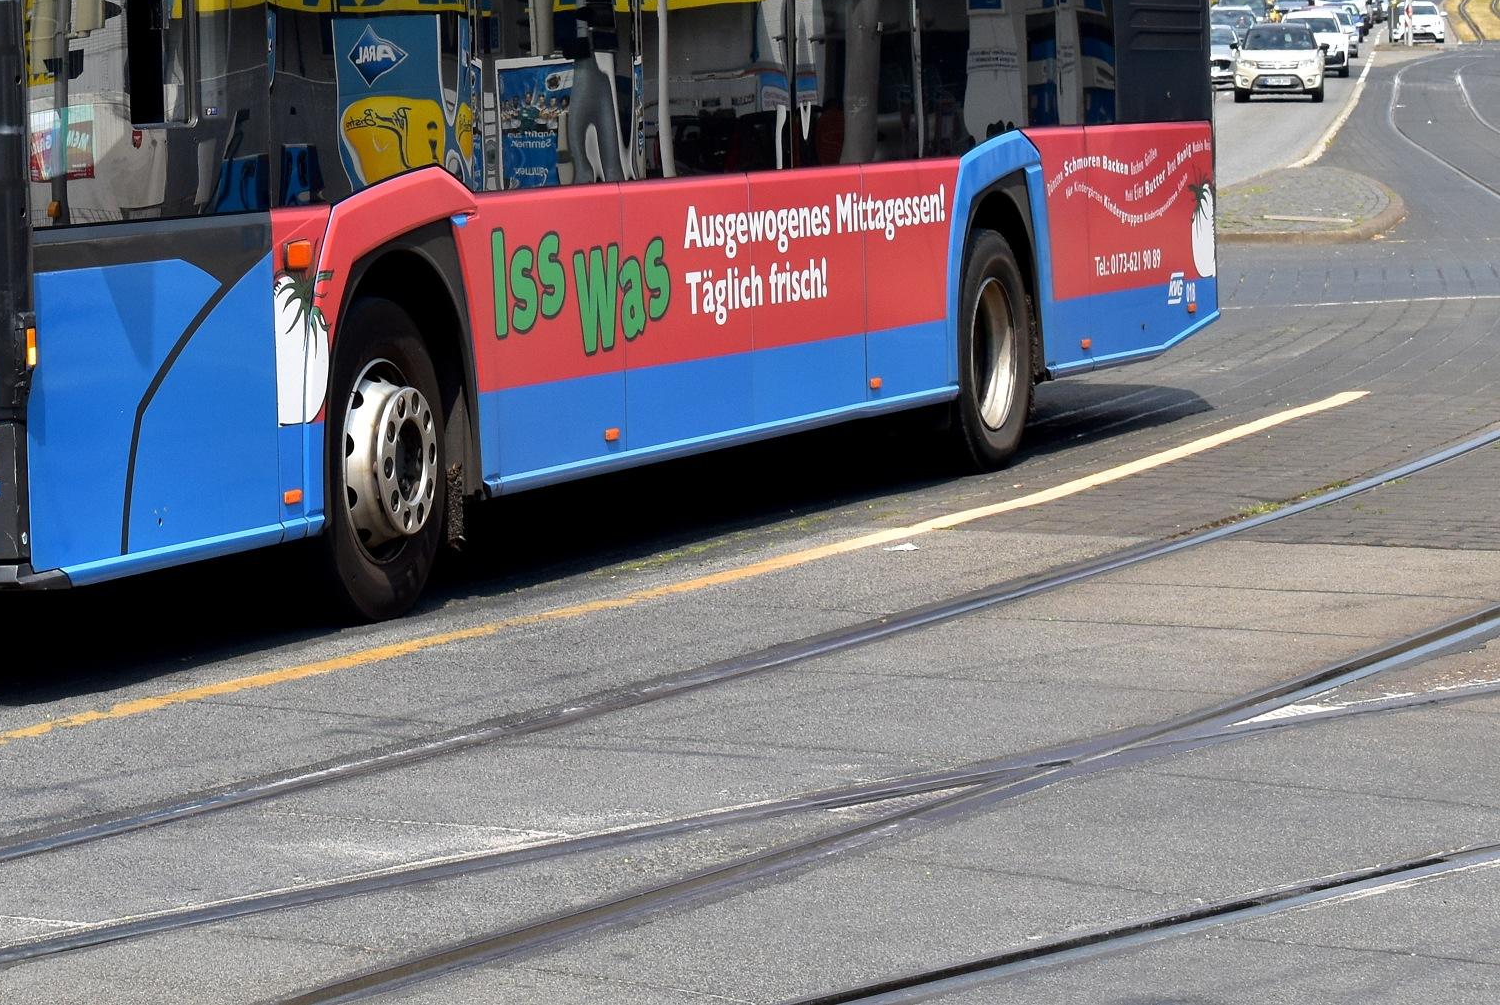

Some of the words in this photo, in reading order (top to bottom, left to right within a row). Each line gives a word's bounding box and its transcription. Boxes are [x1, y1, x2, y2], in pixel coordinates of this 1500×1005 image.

[1064, 156, 1100, 177] Schmoren
[1103, 155, 1130, 176] Backen
[1145, 169, 1166, 197] Butter
[684, 205, 831, 259] Ausgewogenes
[835, 183, 946, 241] Mittagessen!
[491, 227, 566, 340] Iss
[572, 235, 671, 357] Was
[685, 264, 763, 325] Täglich
[769, 256, 828, 305] frisch!
